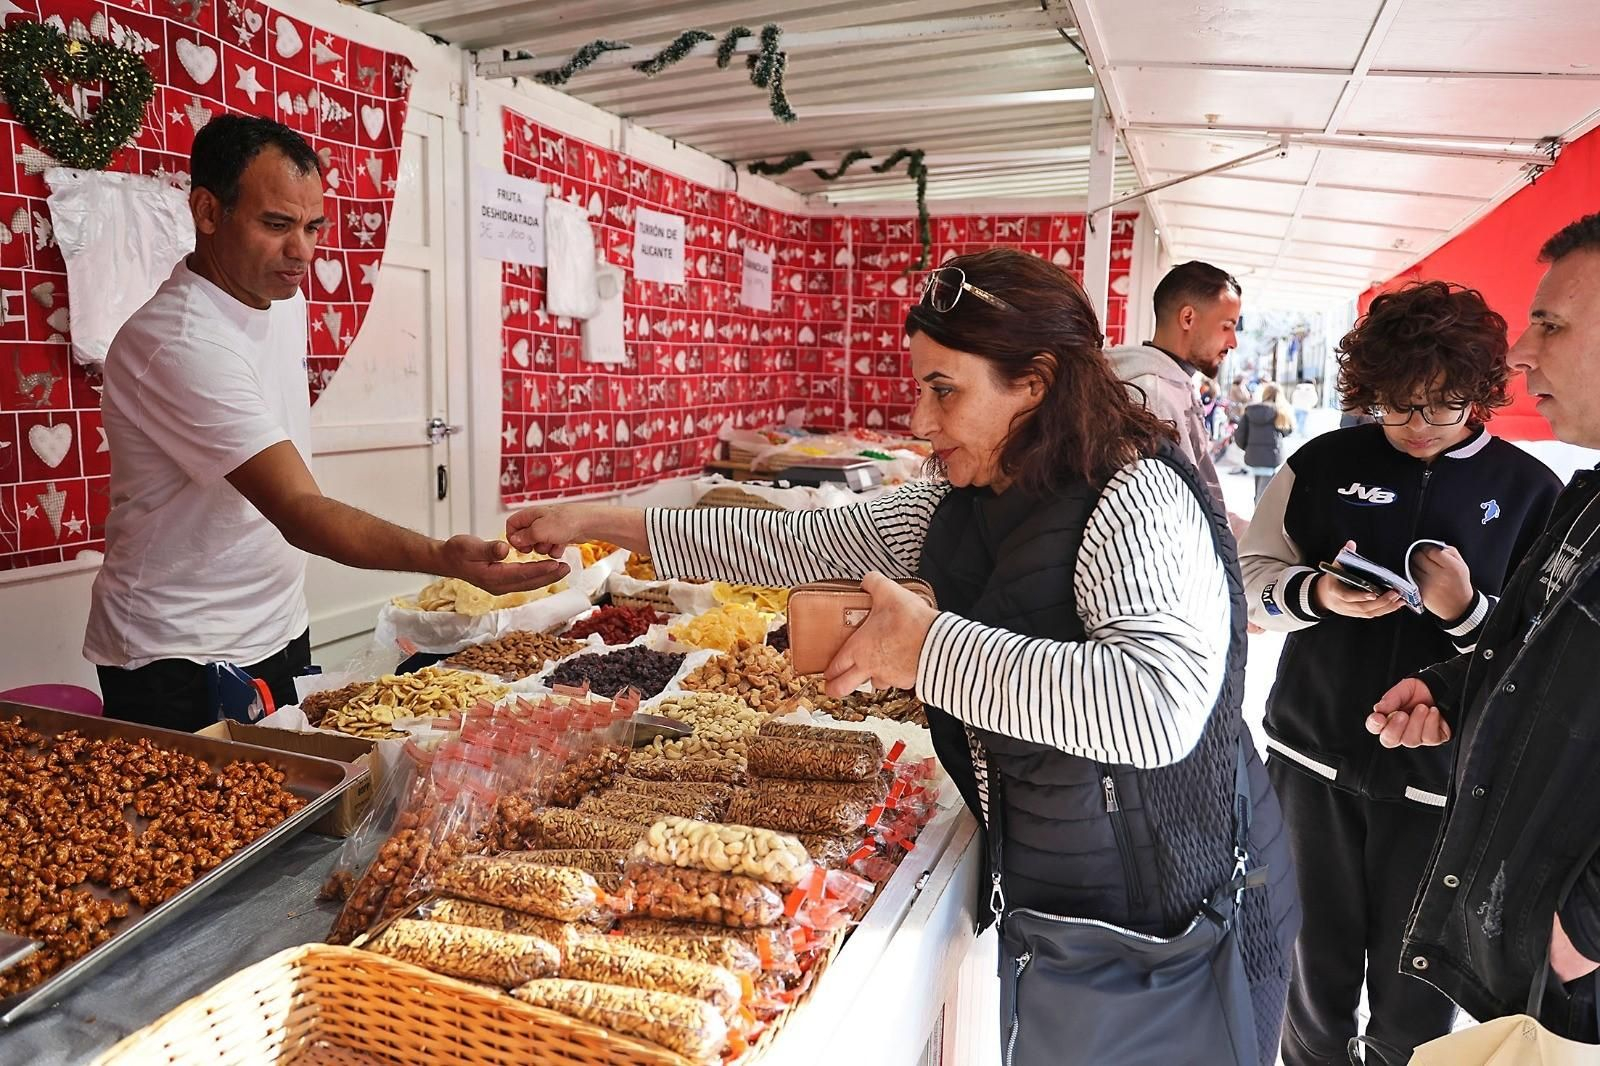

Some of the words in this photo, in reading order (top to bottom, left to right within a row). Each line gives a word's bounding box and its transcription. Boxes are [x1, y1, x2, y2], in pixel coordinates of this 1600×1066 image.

[497, 188, 522, 204] FRUTA
[481, 205, 539, 227] DESHIDRATADA
[639, 221, 665, 238] TURRÓN
[666, 228, 678, 240] DE
[641, 243, 673, 259] ALICANTE
